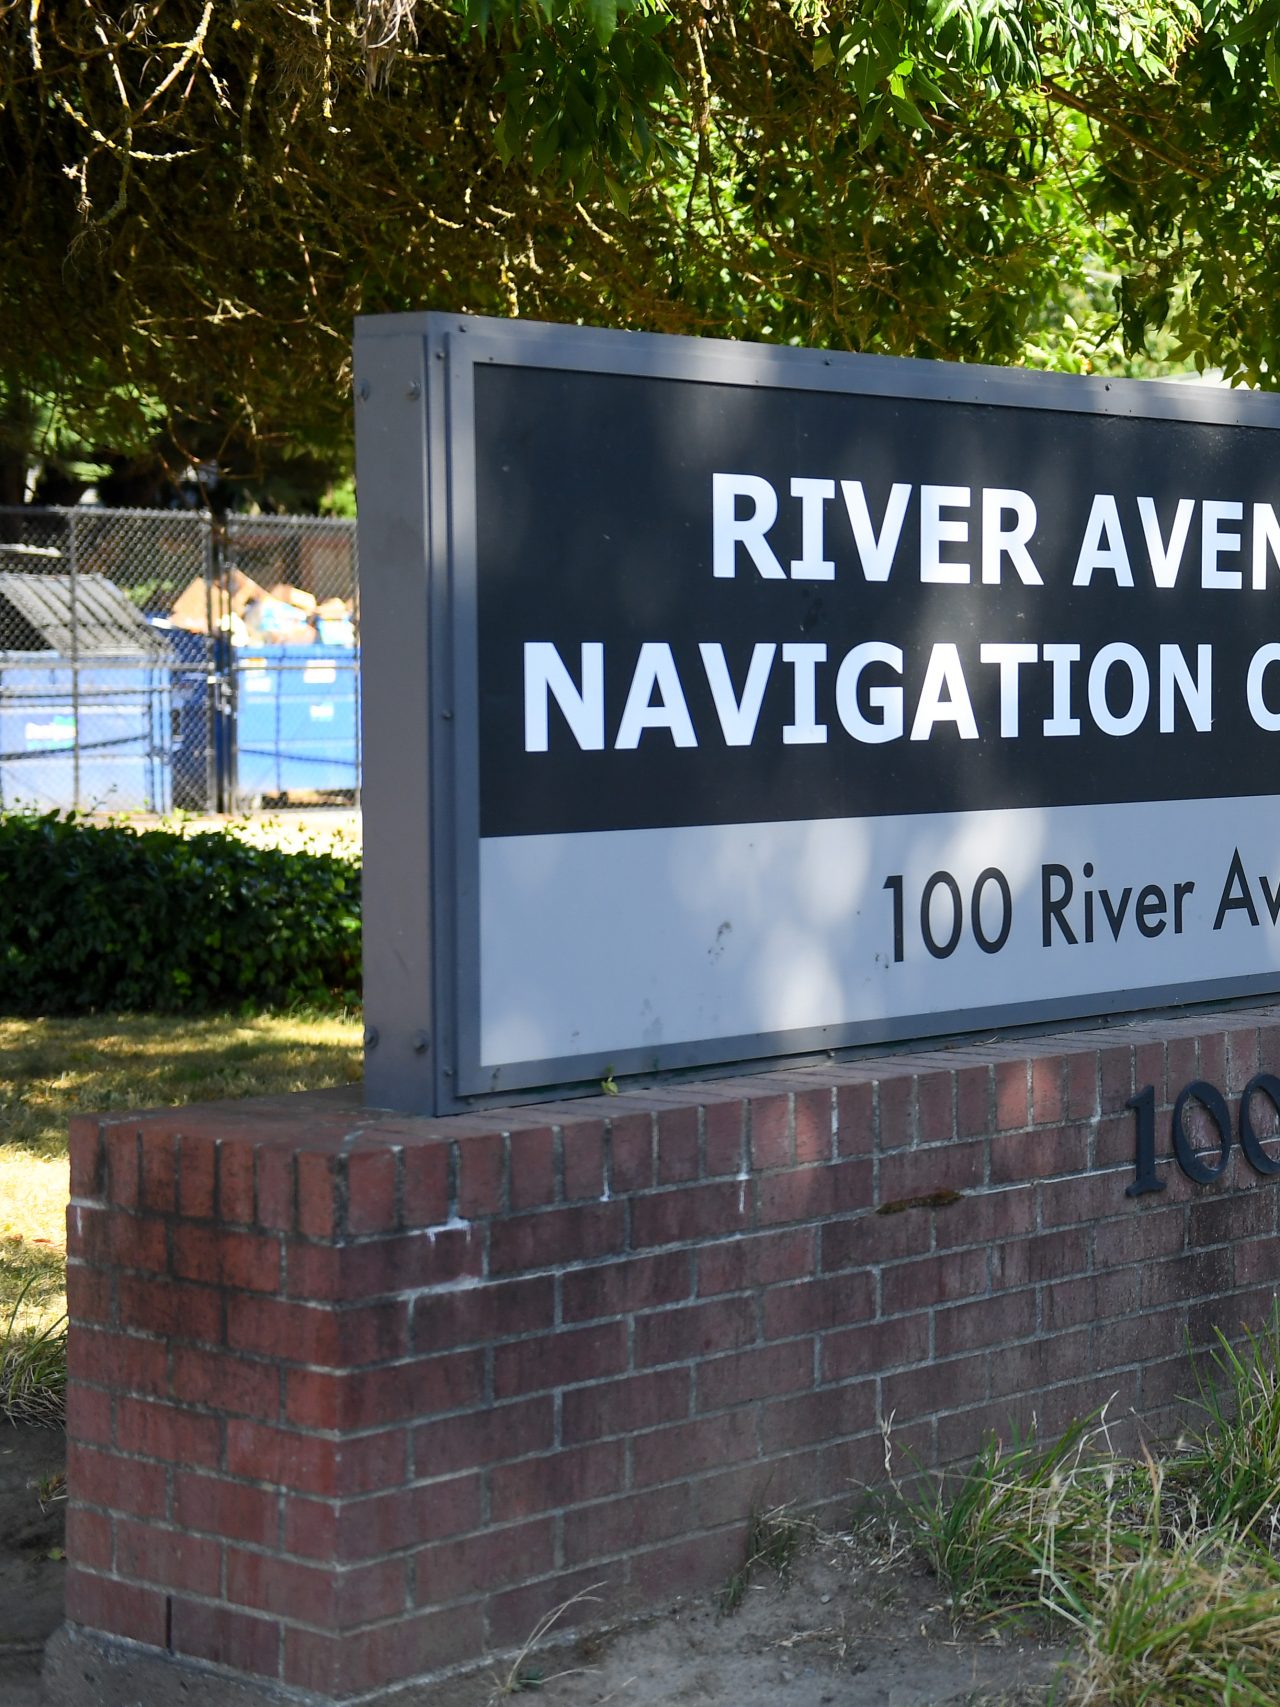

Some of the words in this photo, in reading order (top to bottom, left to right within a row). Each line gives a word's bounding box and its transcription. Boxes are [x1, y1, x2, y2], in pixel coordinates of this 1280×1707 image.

[712, 472, 1045, 586] RIVER
[523, 641, 1212, 752] NAVIGATION
[883, 867, 1013, 963] 100
[1041, 862, 1195, 948] River
